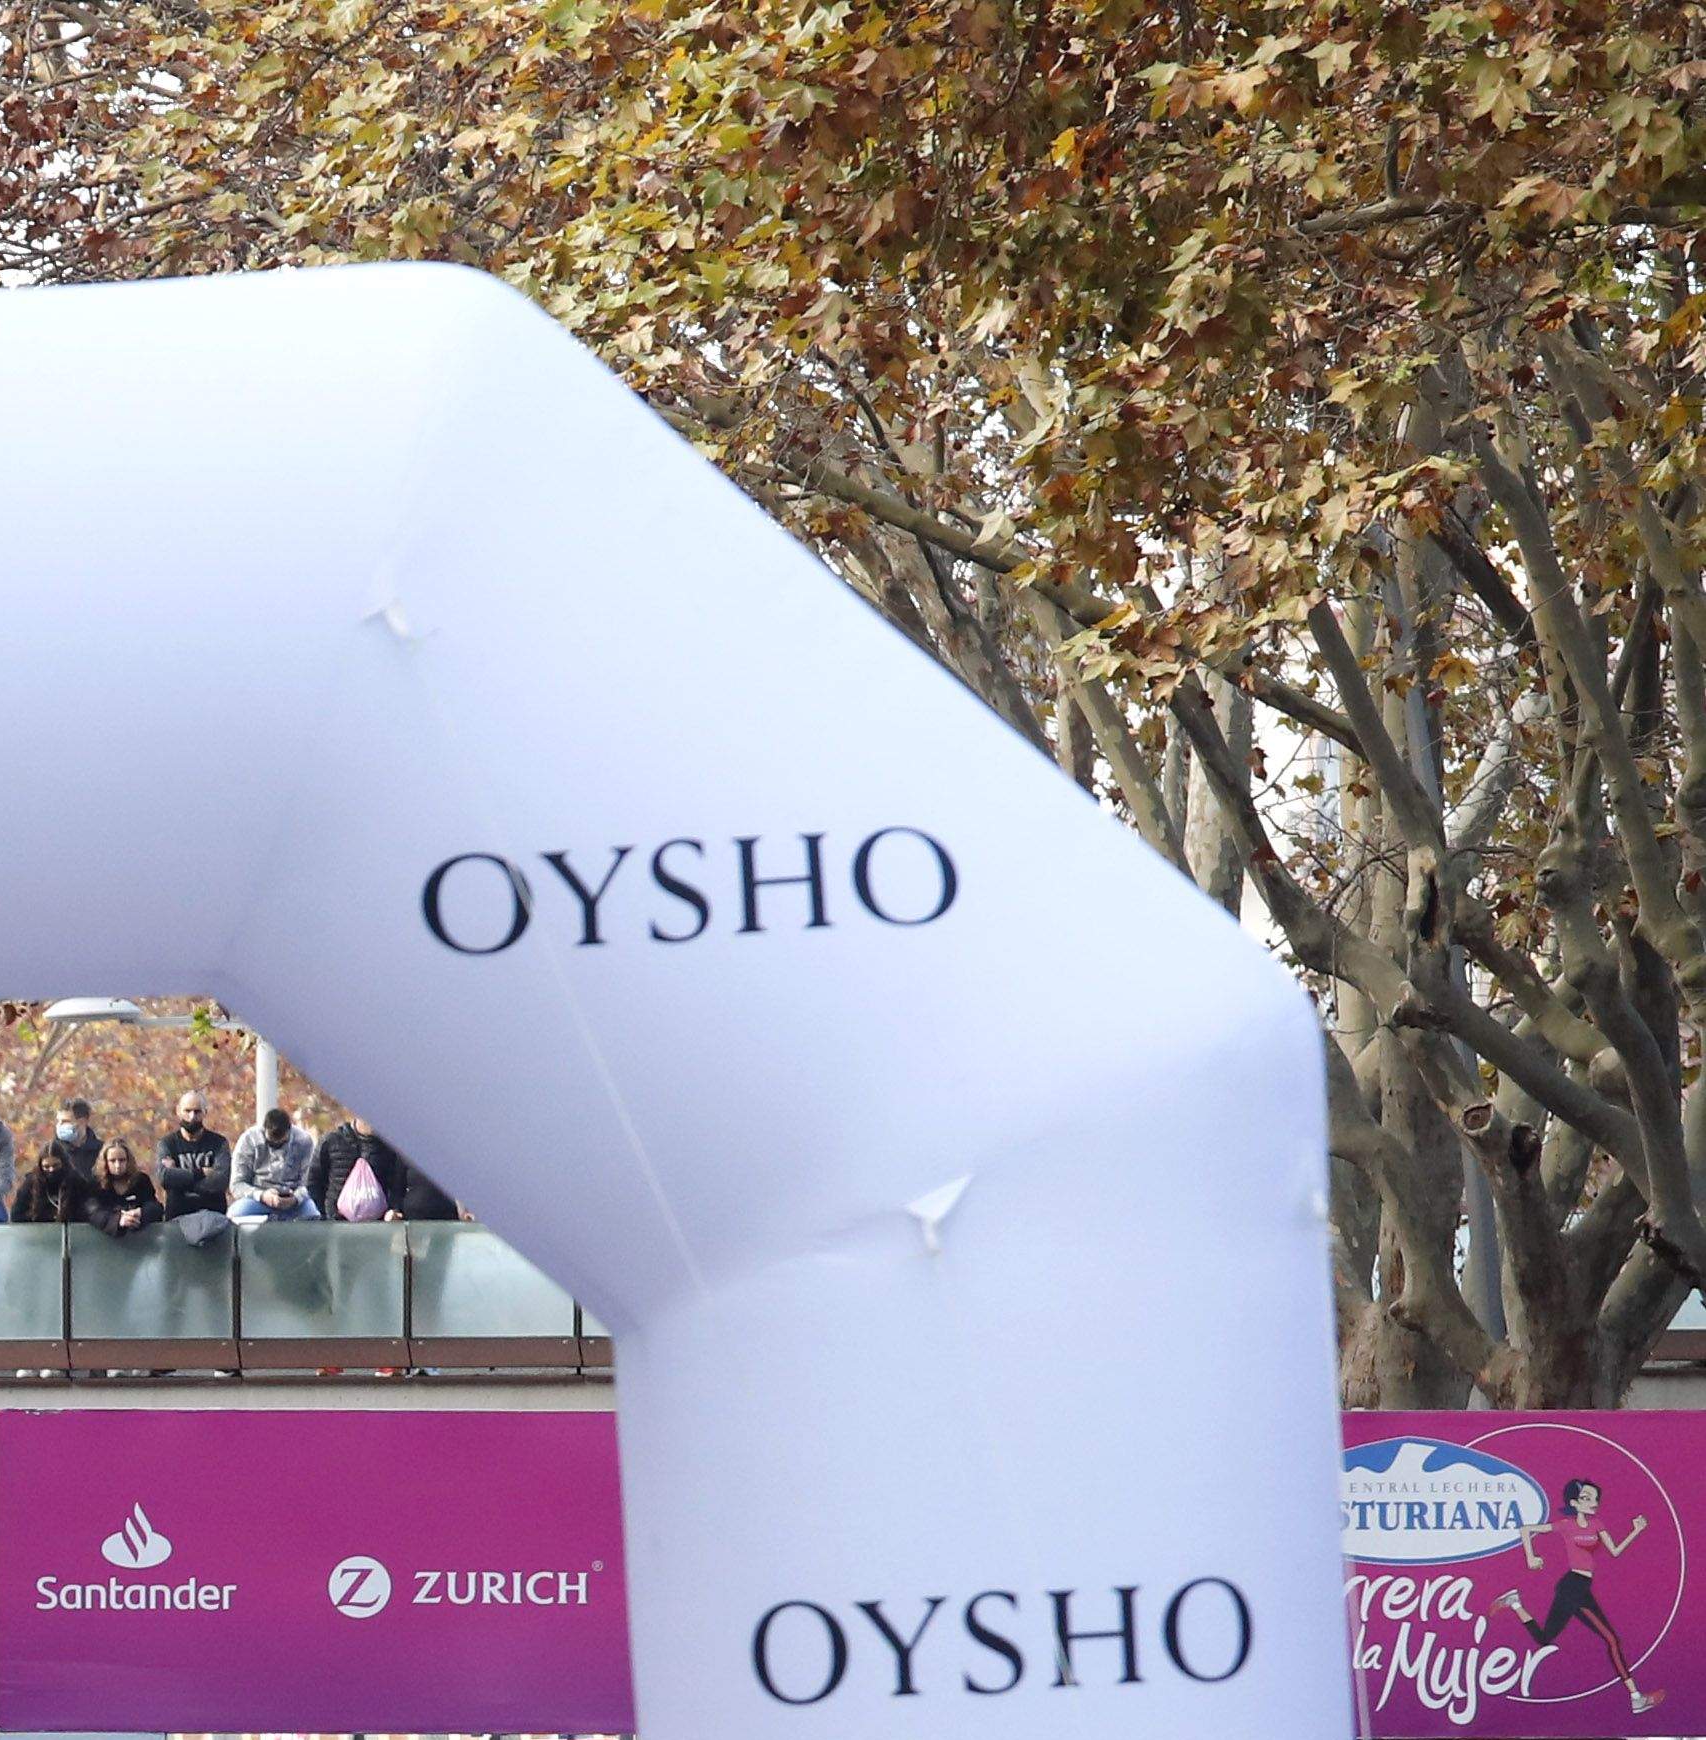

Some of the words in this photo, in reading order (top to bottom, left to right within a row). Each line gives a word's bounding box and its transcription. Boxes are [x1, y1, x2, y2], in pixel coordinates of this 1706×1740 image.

[421, 829, 957, 956] OYSHO
[1340, 1499, 1525, 1531] STURIANA
[1430, 1481, 1518, 1493] LECHERA
[36, 1576, 237, 1611] Santander
[752, 1578, 1253, 1706] OYSHO
[1376, 1613, 1559, 1725] Mujer
